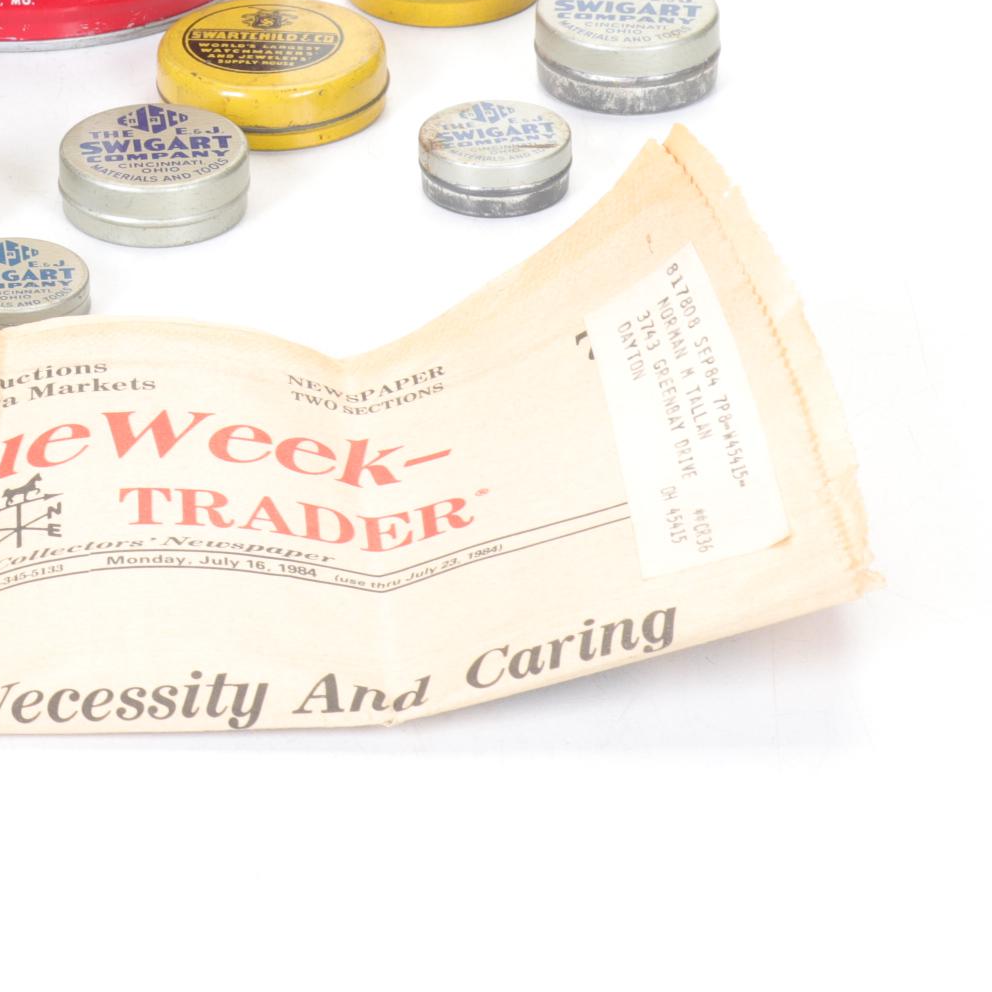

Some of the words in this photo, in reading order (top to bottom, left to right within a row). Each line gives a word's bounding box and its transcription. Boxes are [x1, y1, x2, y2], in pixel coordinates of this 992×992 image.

[555, 0, 702, 17] SWIGART
[557, 13, 696, 24] COMPANY
[191, 31, 298, 41] SWARTCHILD
[560, 20, 618, 41] MATERIALS
[655, 26, 691, 39] TOOLS
[80, 136, 232, 155] SWIGART
[88, 130, 134, 139] THE
[87, 150, 230, 163] COMPANY
[91, 165, 158, 182] MATERIALS
[163, 173, 191, 182] AND
[193, 159, 228, 175] TOOLS
[43, 288, 73, 302] TOOLS
[657, 296, 688, 360] NORMAN
[666, 262, 701, 329] 817808
[694, 335, 720, 387] SEP84
[617, 321, 646, 381] DAYTON
[287, 364, 446, 404] NEWSPAPER
[680, 366, 694, 380] M
[29, 376, 157, 402] Markets
[291, 389, 338, 412] TWO
[342, 382, 445, 416] SECTIONS
[637, 309, 661, 351] 3743
[653, 358, 686, 433] GREENBAY
[674, 438, 698, 480] DRIVE
[686, 384, 713, 440] TALLAN
[47, 502, 62, 519] N
[47, 524, 62, 537] E
[666, 507, 687, 544] 45415
[165, 535, 336, 566] Newspaper
[106, 554, 193, 567] Monday,
[199, 554, 242, 570] July
[246, 558, 273, 573] 16,
[278, 563, 318, 579] 1984
[333, 573, 367, 588] (use
[370, 575, 402, 590] thru
[404, 565, 437, 584] July
[441, 556, 462, 571] 23,
[467, 543, 504, 560] 1984)
[292, 672, 431, 715] And
[465, 606, 677, 690] Caring
